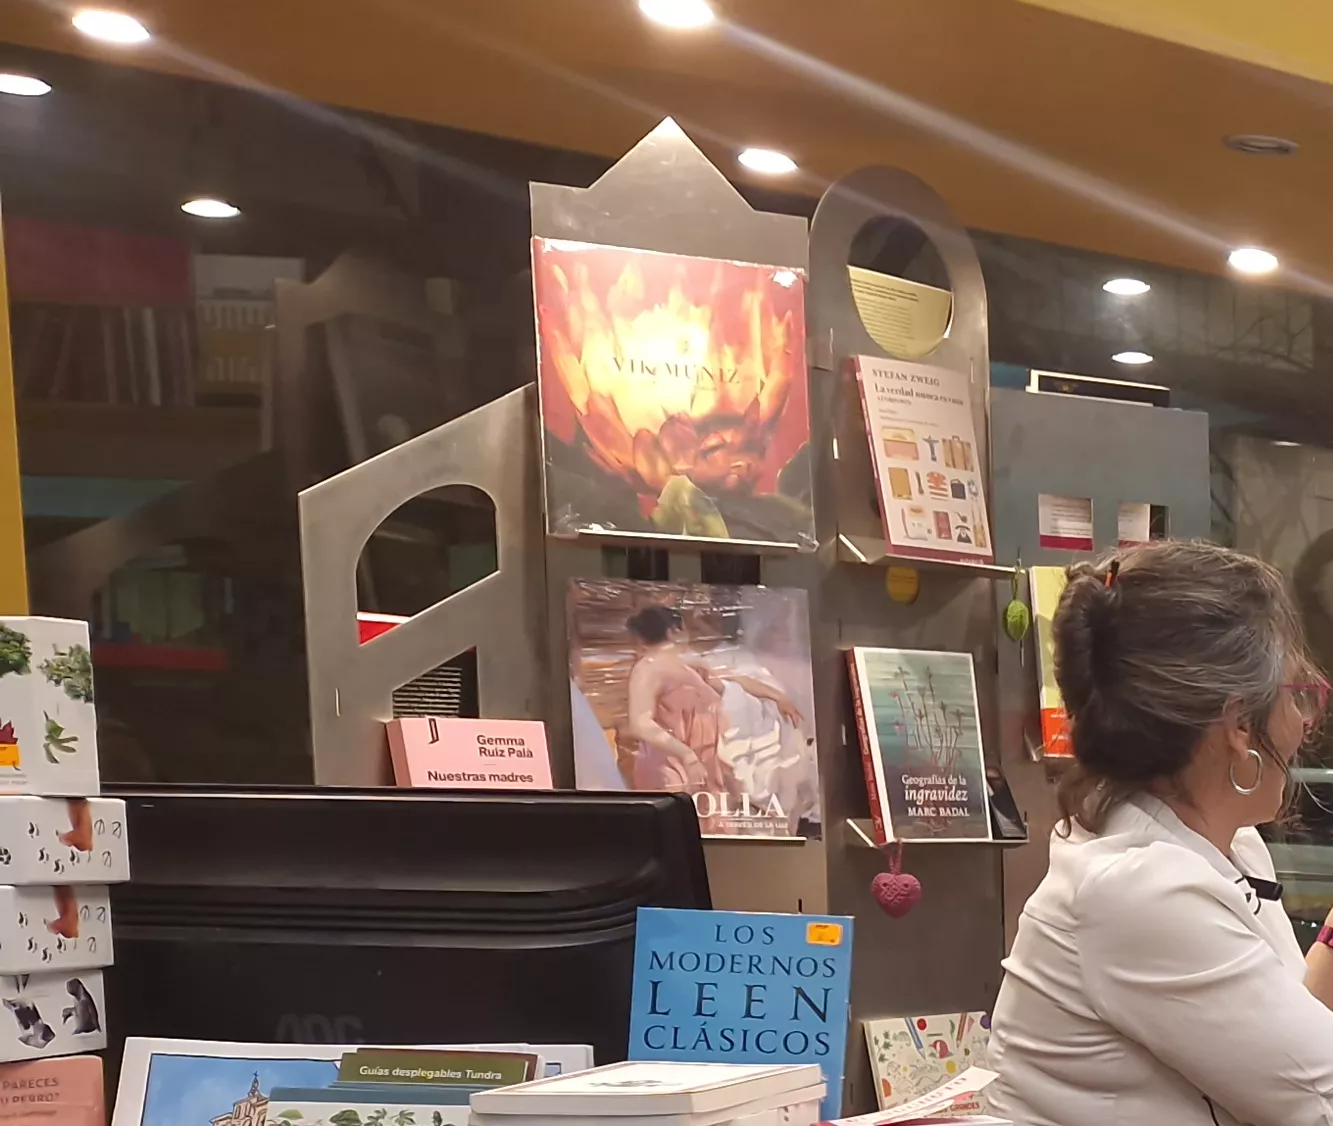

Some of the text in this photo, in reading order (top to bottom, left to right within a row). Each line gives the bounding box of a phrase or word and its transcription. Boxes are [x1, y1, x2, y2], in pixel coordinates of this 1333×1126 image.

[613, 357, 740, 383] VIK MUNIZ
[872, 369, 940, 386] STEFAN ZWEIG
[477, 734, 525, 746] Gemma
[478, 747, 506, 758] Ruiz
[427, 771, 534, 782] Nuestras madres
[947, 774, 957, 785] de
[958, 774, 967, 785] la
[905, 785, 968, 805] ingravidez
[692, 791, 788, 818] OLLA
[907, 807, 970, 817] MARC BADAL
[715, 924, 775, 945] LOS
[649, 950, 835, 978] MODERNOS
[647, 980, 832, 1023] LEEN
[643, 1021, 829, 1057] CLÁSICOS
[360, 1065, 502, 1080] Guías desplegables Tundra
[2, 1077, 59, 1089] PARECES
